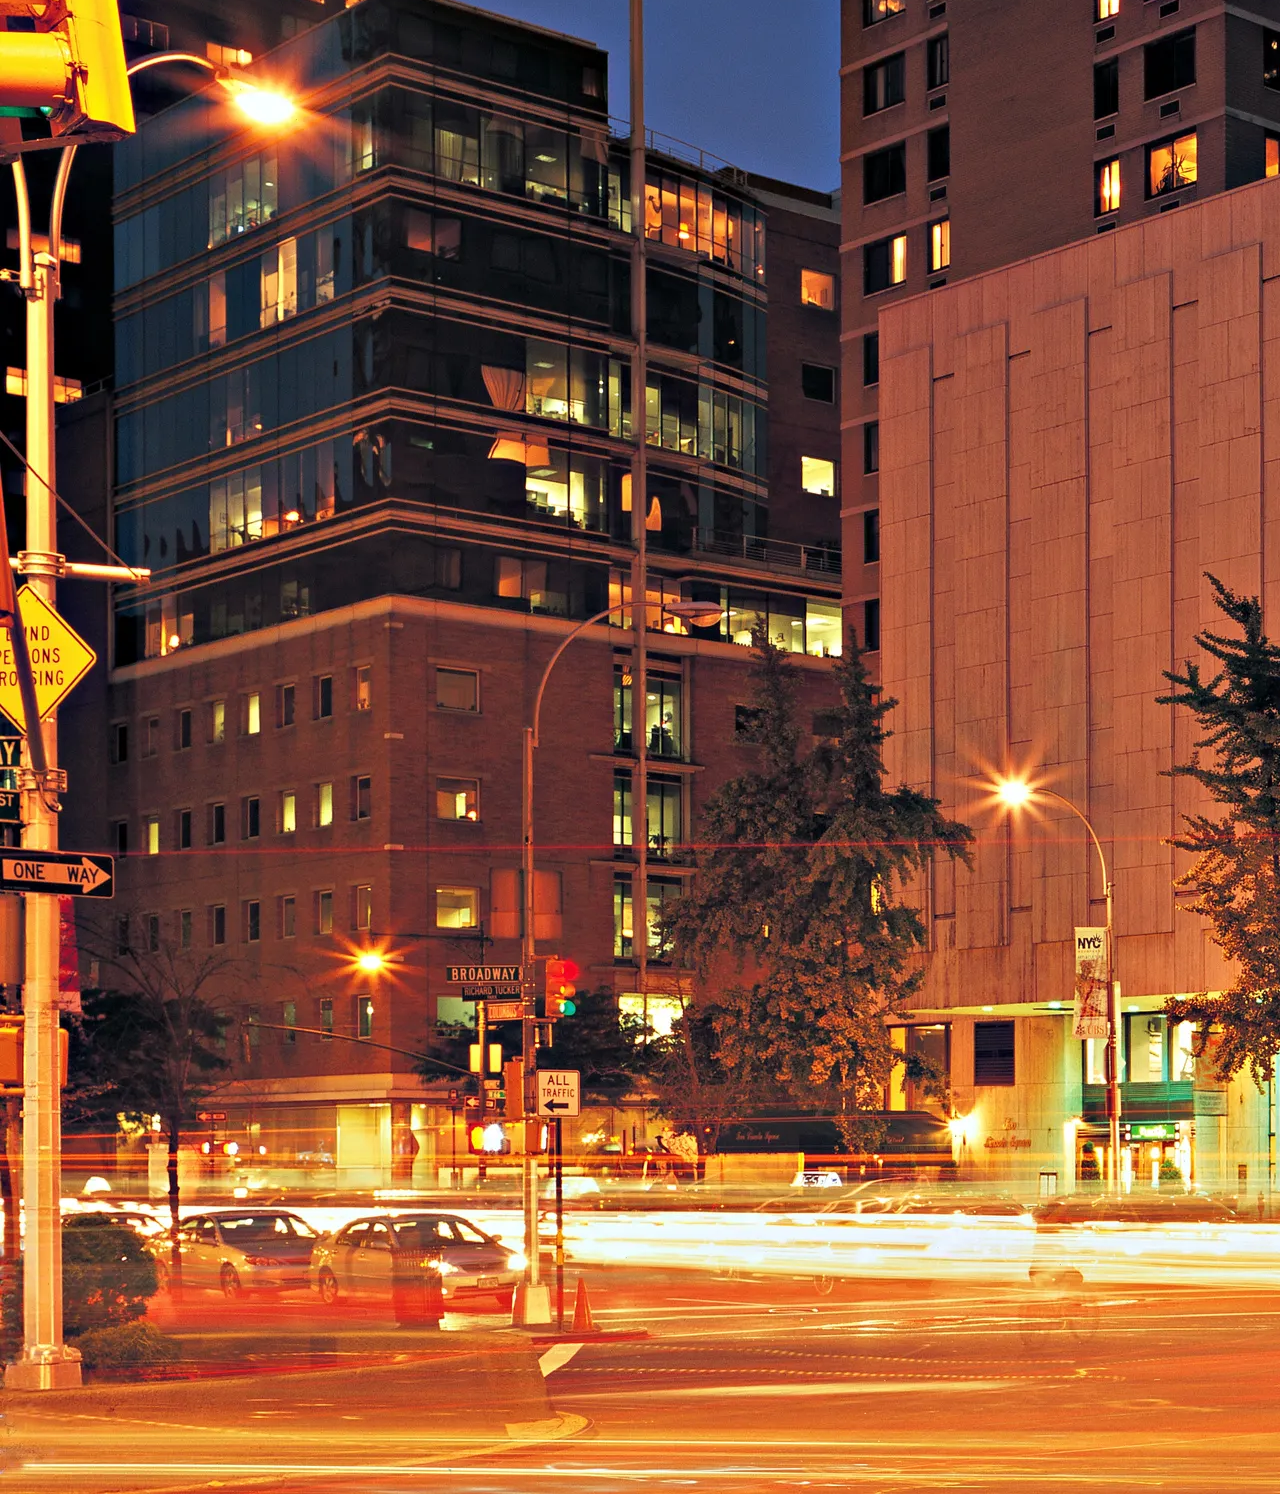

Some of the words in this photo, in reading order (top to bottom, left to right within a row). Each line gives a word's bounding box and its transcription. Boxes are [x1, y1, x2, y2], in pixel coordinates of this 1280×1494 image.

[0, 648, 61, 664] EONS
[13, 862, 46, 880] ONE
[67, 866, 99, 884] WAY
[1078, 936, 1102, 949] NYC
[451, 968, 516, 981] BROADWAY
[464, 986, 492, 996] RICHARD
[495, 985, 520, 994] TUCKER
[488, 1005, 517, 1018] COLUMBUS
[1087, 1024, 1104, 1035] UBS
[547, 1074, 570, 1086] ALL
[542, 1088, 575, 1098] TRAFFIC
